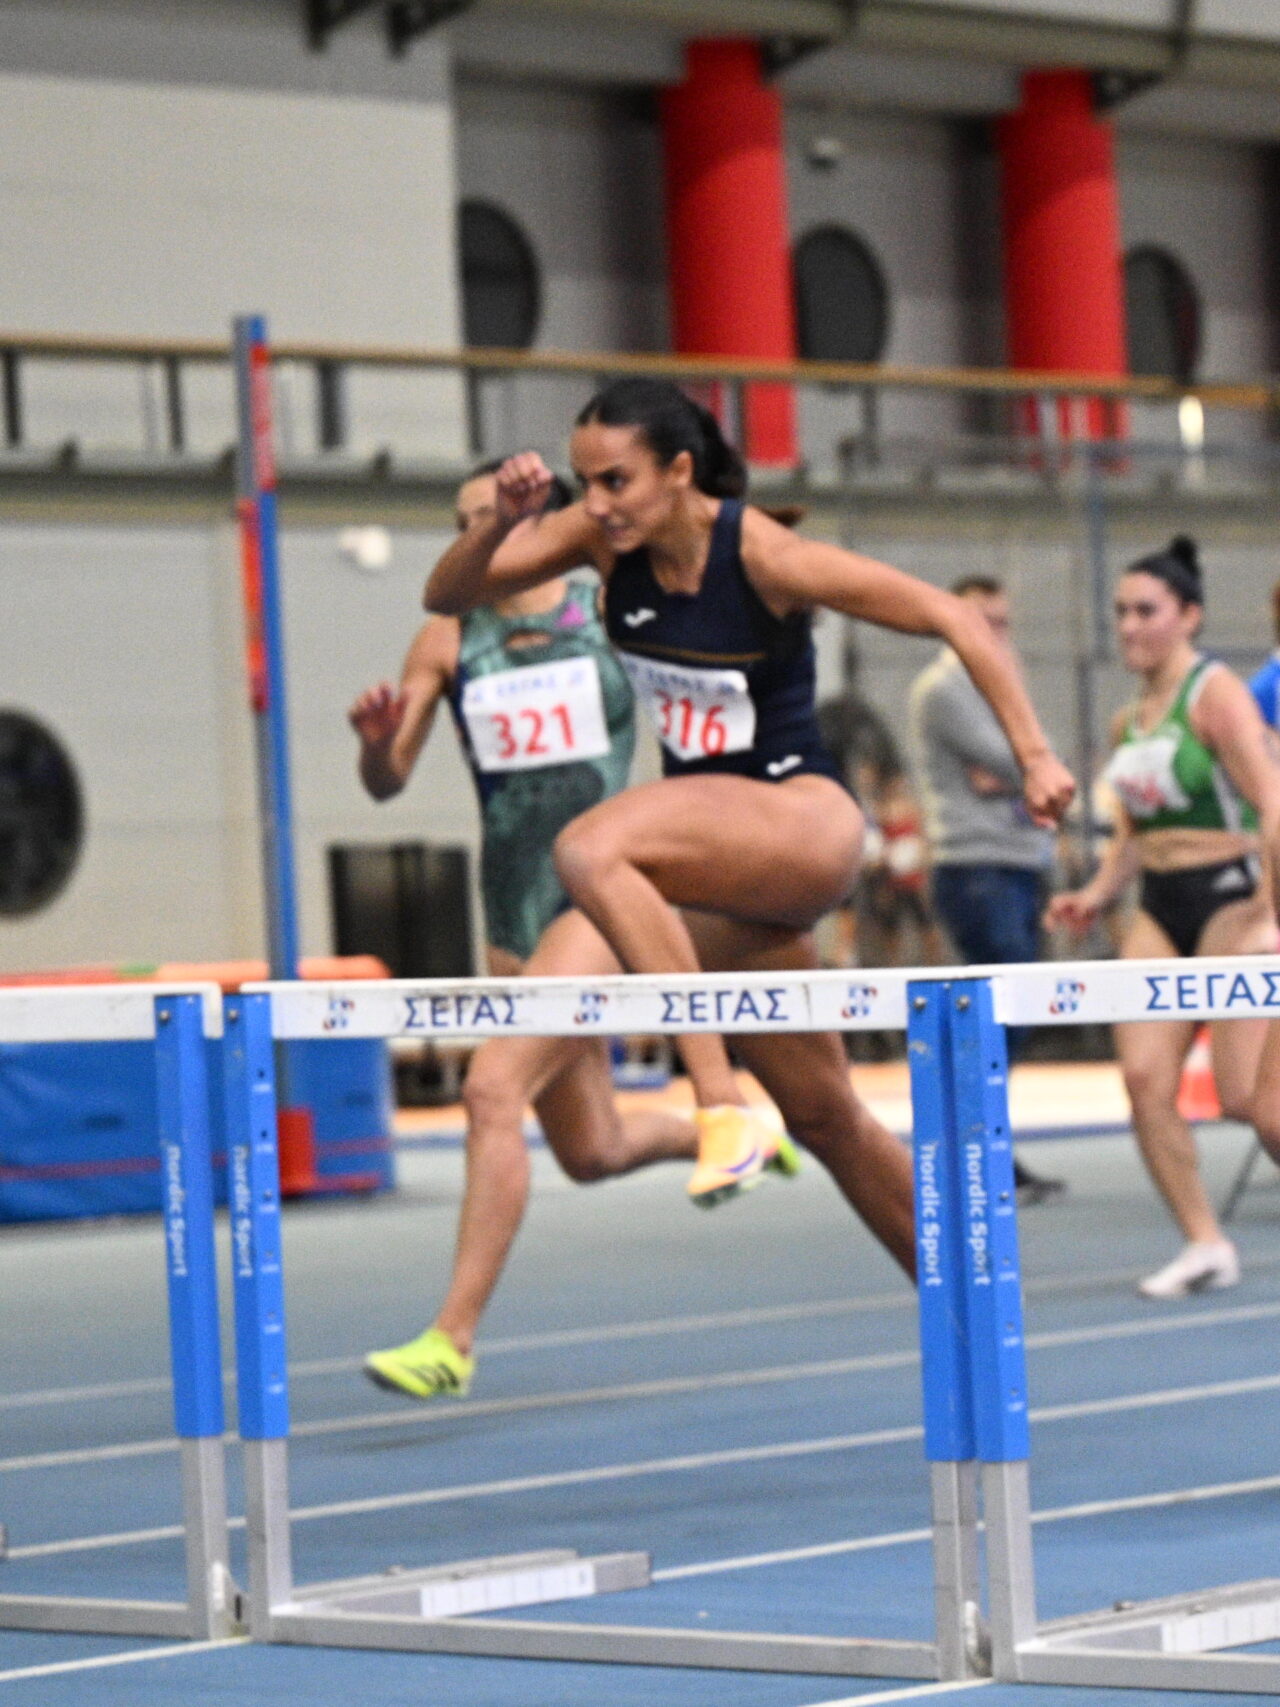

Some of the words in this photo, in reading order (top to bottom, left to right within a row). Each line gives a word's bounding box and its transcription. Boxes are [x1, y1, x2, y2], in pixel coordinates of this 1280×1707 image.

[490, 703, 575, 759] 321
[655, 690, 727, 757] 316
[404, 993, 521, 1028] ΣΕΓΑΣ
[660, 987, 789, 1023] ΣΕΓΑΣ
